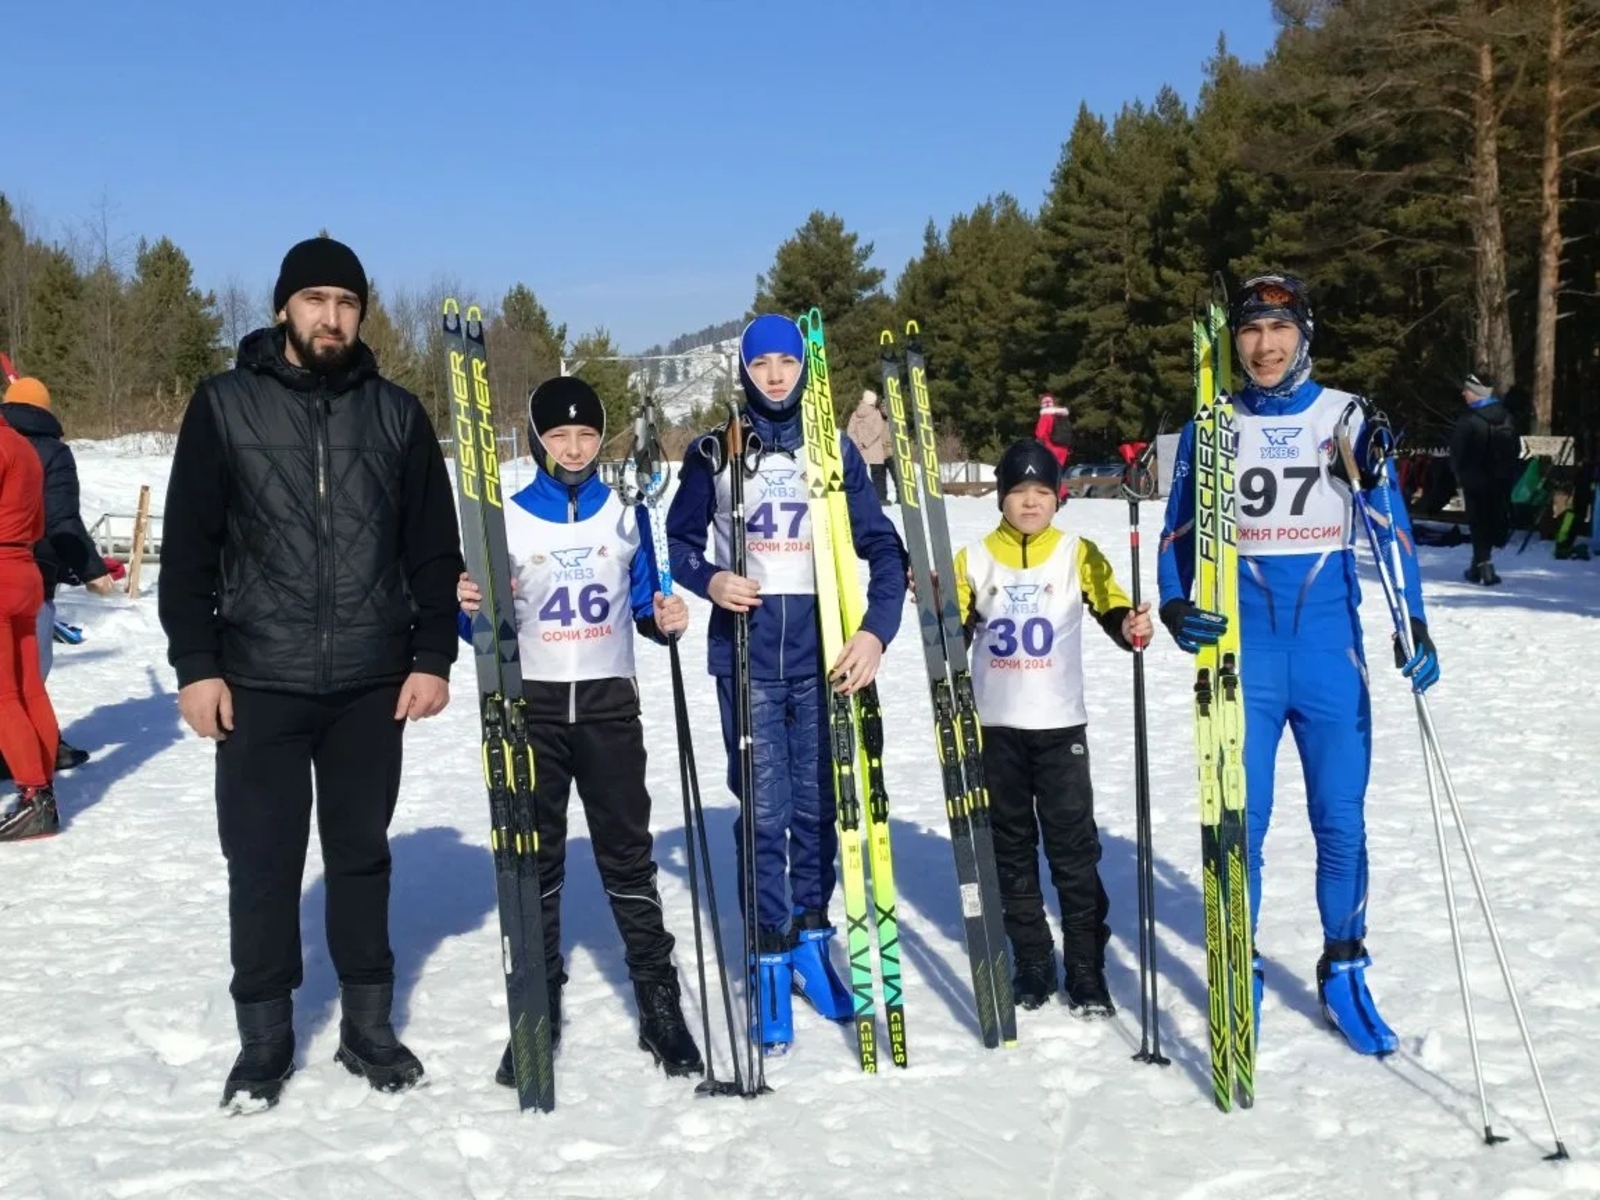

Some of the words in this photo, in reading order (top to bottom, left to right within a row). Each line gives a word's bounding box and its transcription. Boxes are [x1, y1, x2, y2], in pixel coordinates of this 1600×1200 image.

[811, 341, 837, 460] FISCHER
[450, 351, 479, 500] FISCHER
[472, 358, 502, 508] FISCHER
[887, 377, 918, 508] FISCHER
[912, 366, 942, 499] FISCHER
[1260, 446, 1299, 459] УКВЗ
[760, 487, 797, 499] УКВЗ
[1200, 425, 1216, 562] FISCHER
[1219, 410, 1236, 547] FISCHER
[1239, 466, 1320, 518] 97
[745, 502, 809, 540] 47
[1236, 528, 1272, 541] ЖНЯ
[1277, 525, 1341, 541] РОССИИ
[748, 542, 780, 553] СОЧИ
[784, 541, 811, 552] 2014
[553, 567, 595, 582] УКВЗ
[538, 583, 610, 627] 46
[542, 630, 580, 643] СОЧИ
[584, 624, 612, 639] 2014
[987, 617, 1054, 657] 30
[990, 659, 1020, 669] СОЧИ
[1024, 659, 1052, 669] 2014
